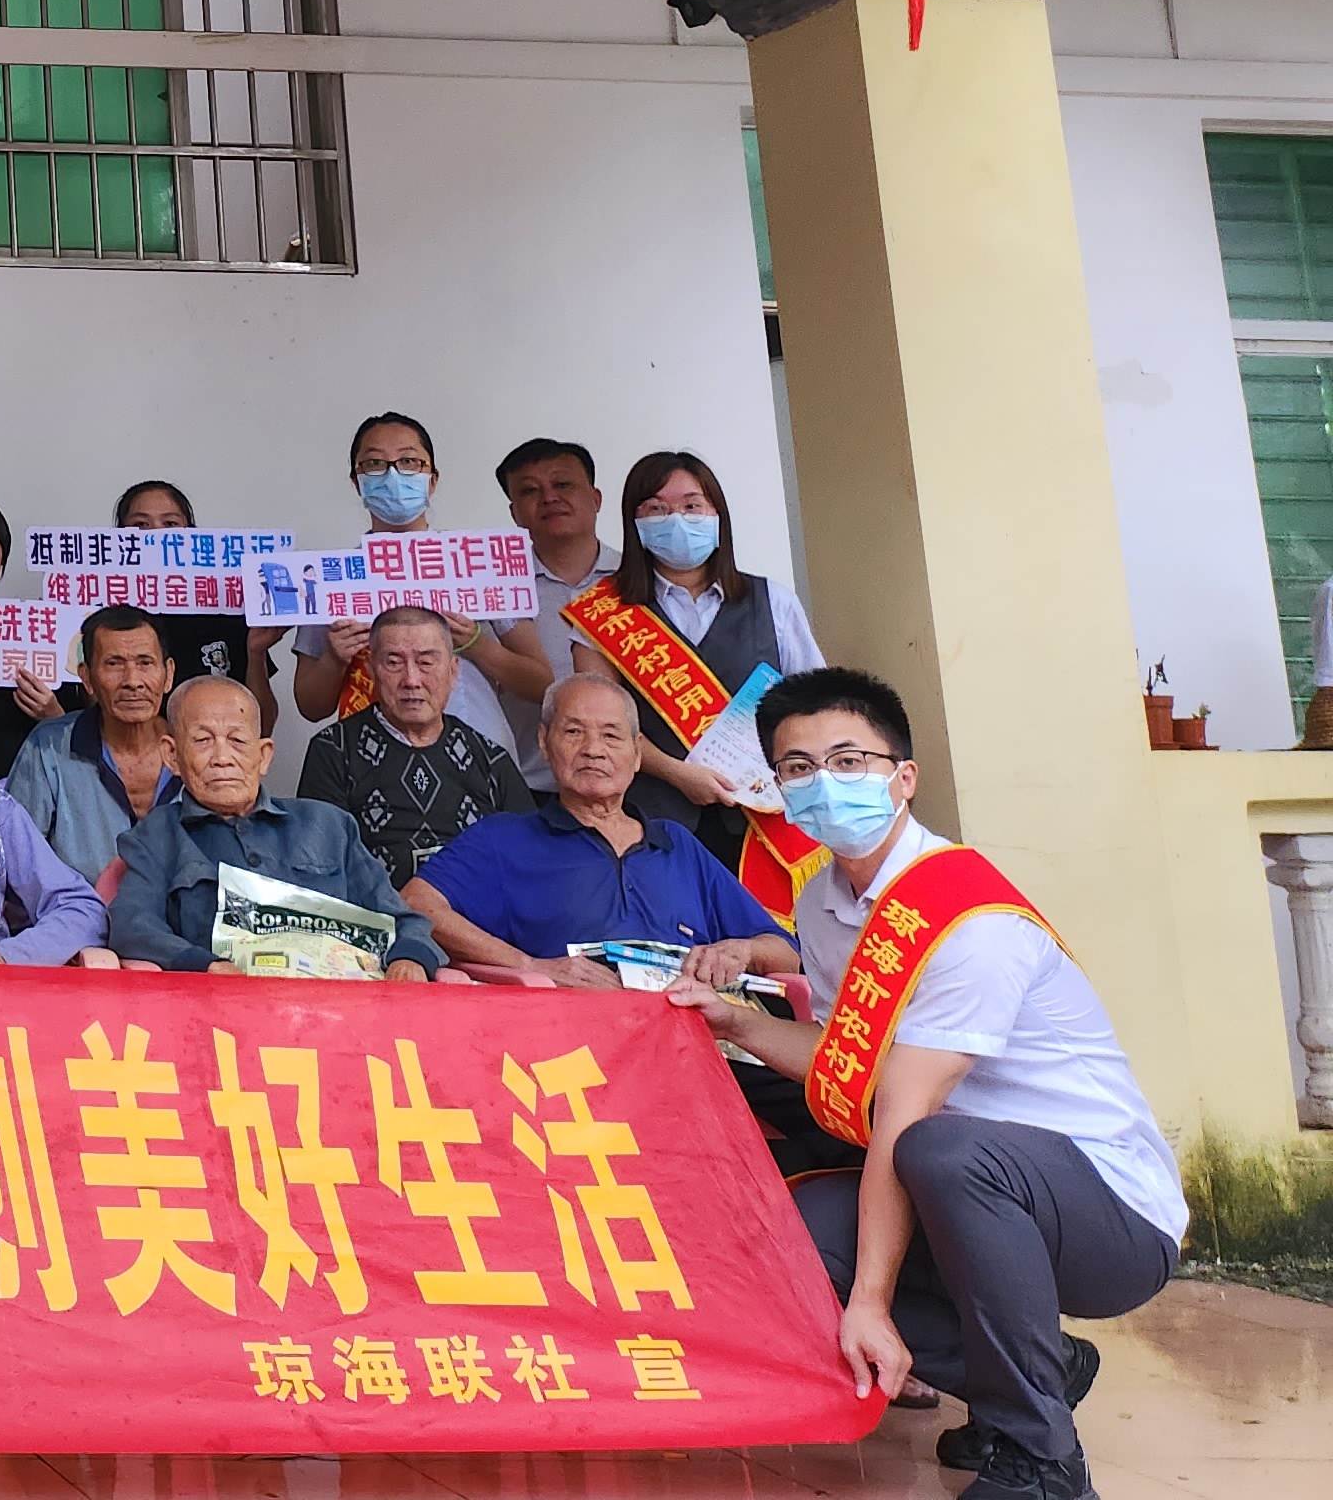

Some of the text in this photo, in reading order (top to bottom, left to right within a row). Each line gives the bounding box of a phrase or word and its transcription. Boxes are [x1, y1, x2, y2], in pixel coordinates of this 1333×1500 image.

[320, 534, 530, 582] 警惕电信诈骗
[252, 910, 361, 939] GOLDROAST
[242, 1332, 702, 1405] 琼海联社 宣
